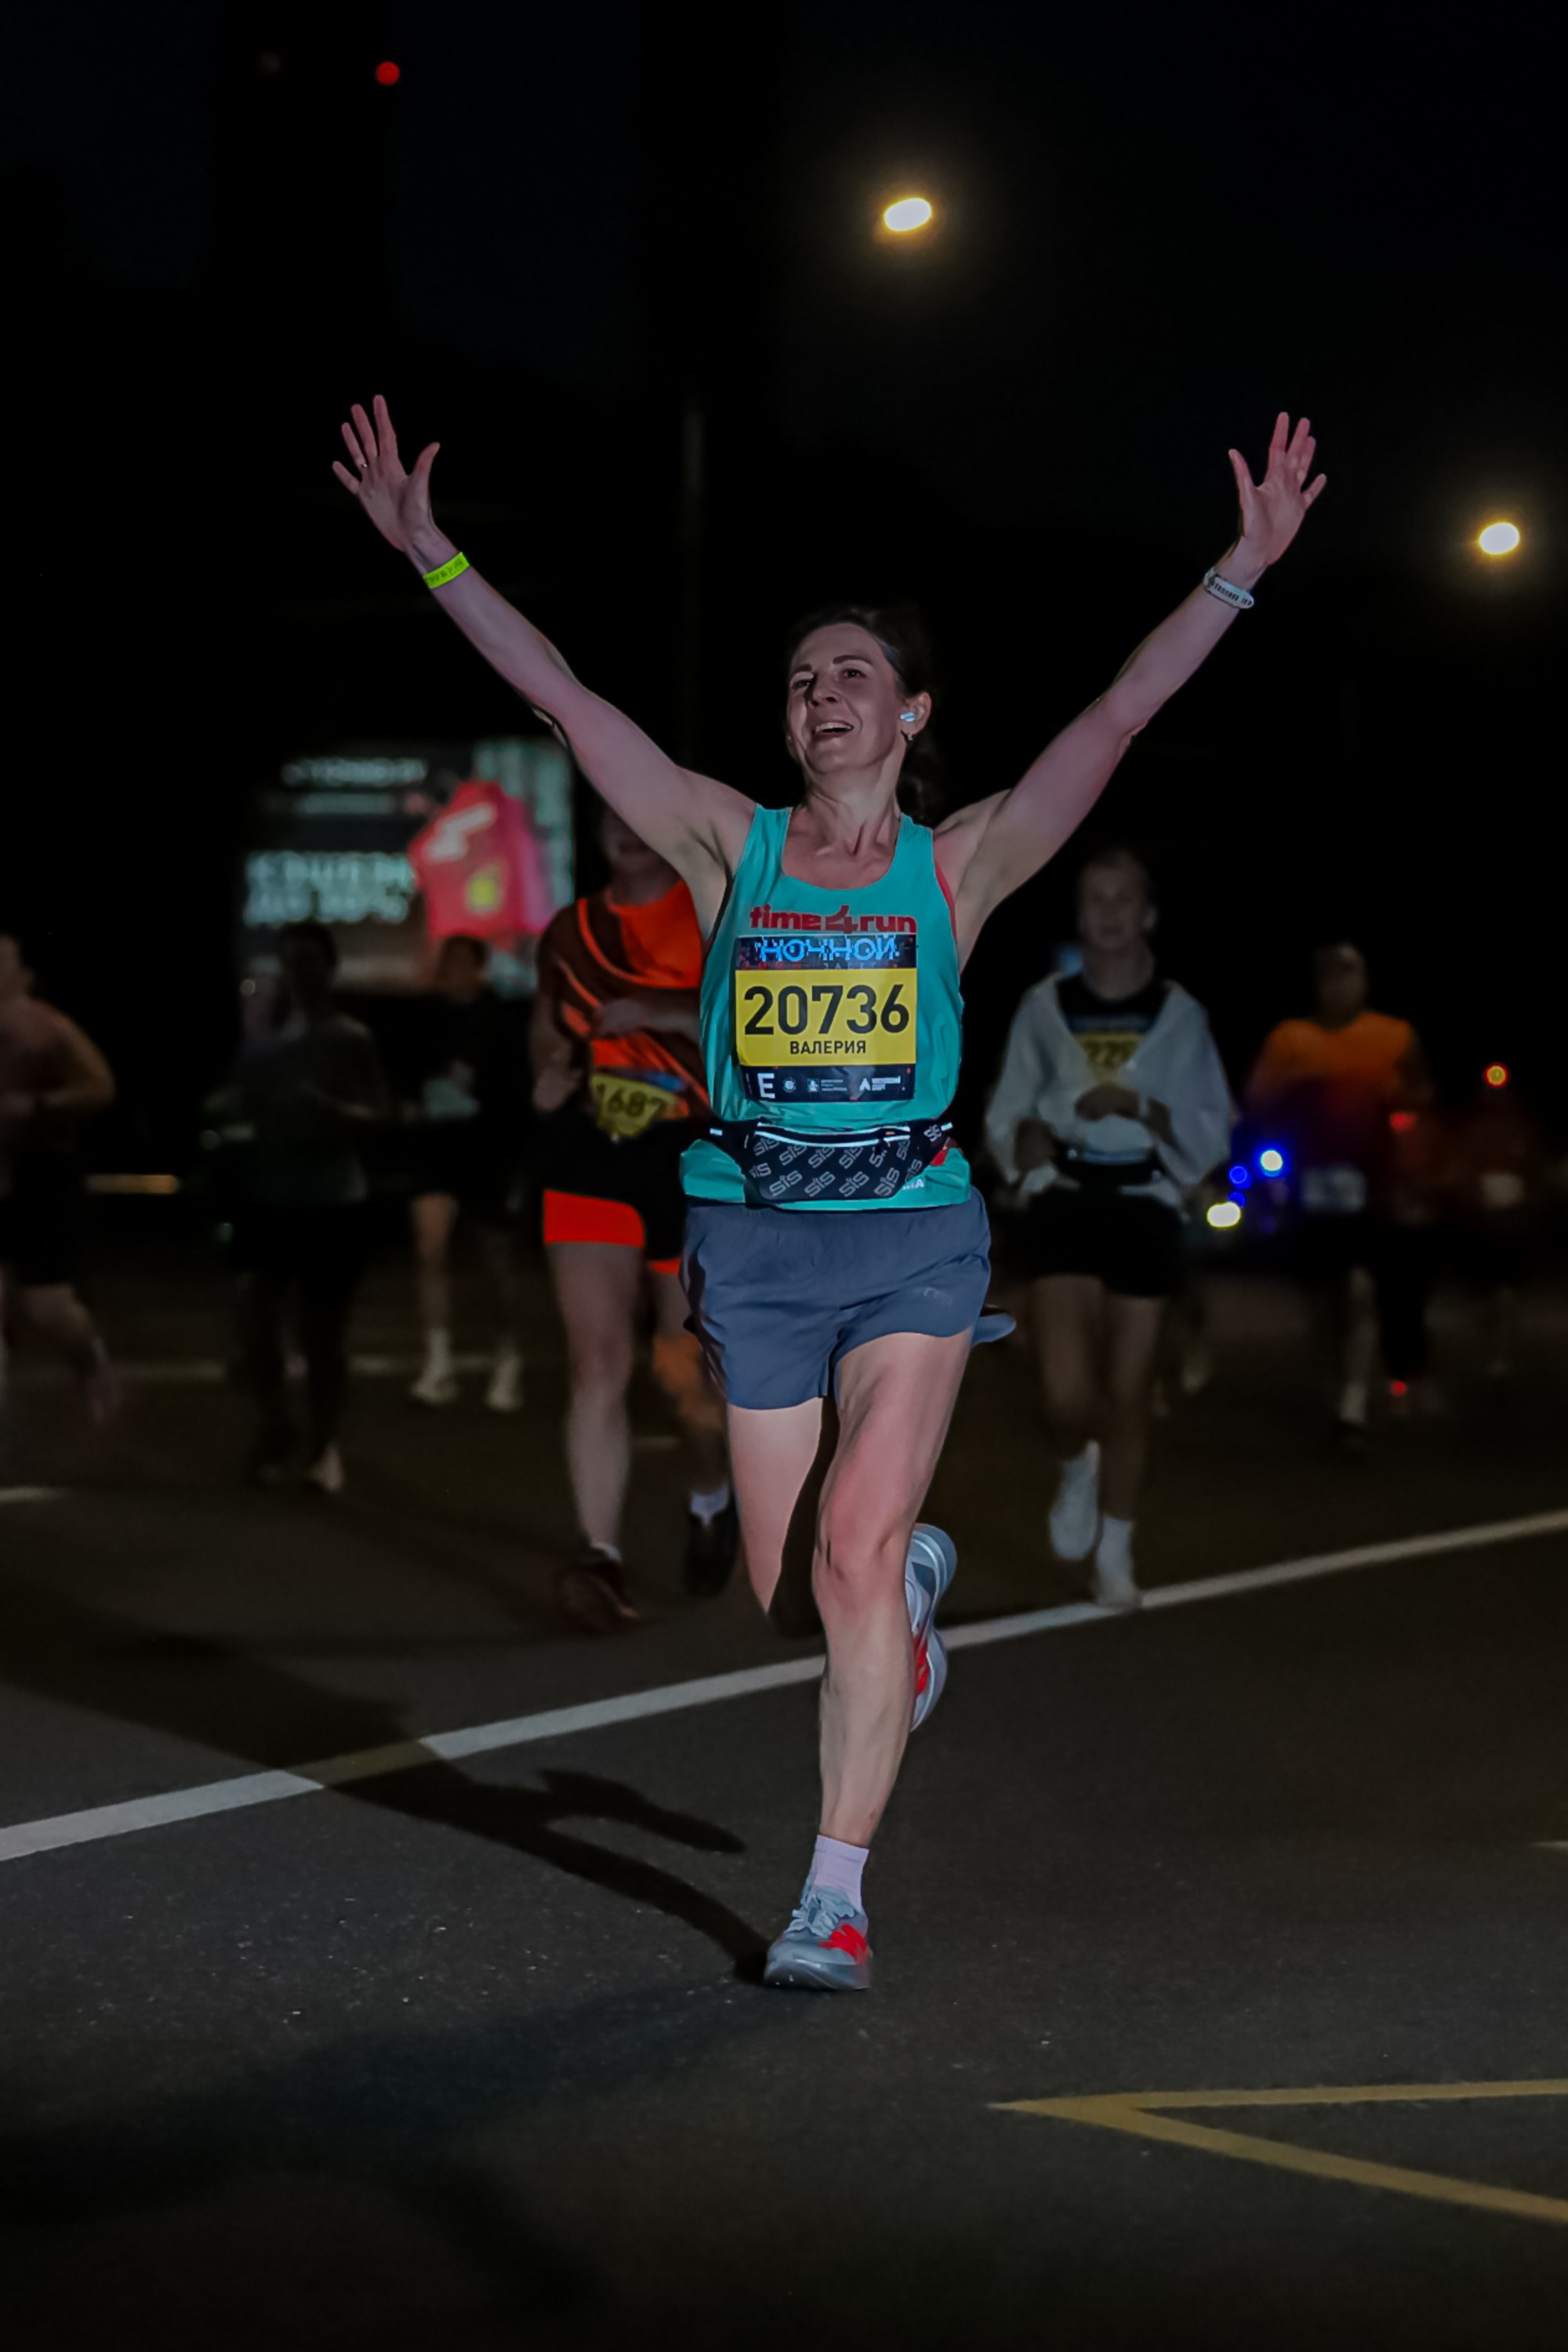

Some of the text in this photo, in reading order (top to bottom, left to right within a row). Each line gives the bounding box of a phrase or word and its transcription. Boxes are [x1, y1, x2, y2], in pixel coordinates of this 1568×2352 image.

[750, 904, 916, 934] time4run
[744, 984, 909, 1036] 20736
[790, 1040, 866, 1054] ВАЛЕРИЯ
[757, 1073, 775, 1098] E
